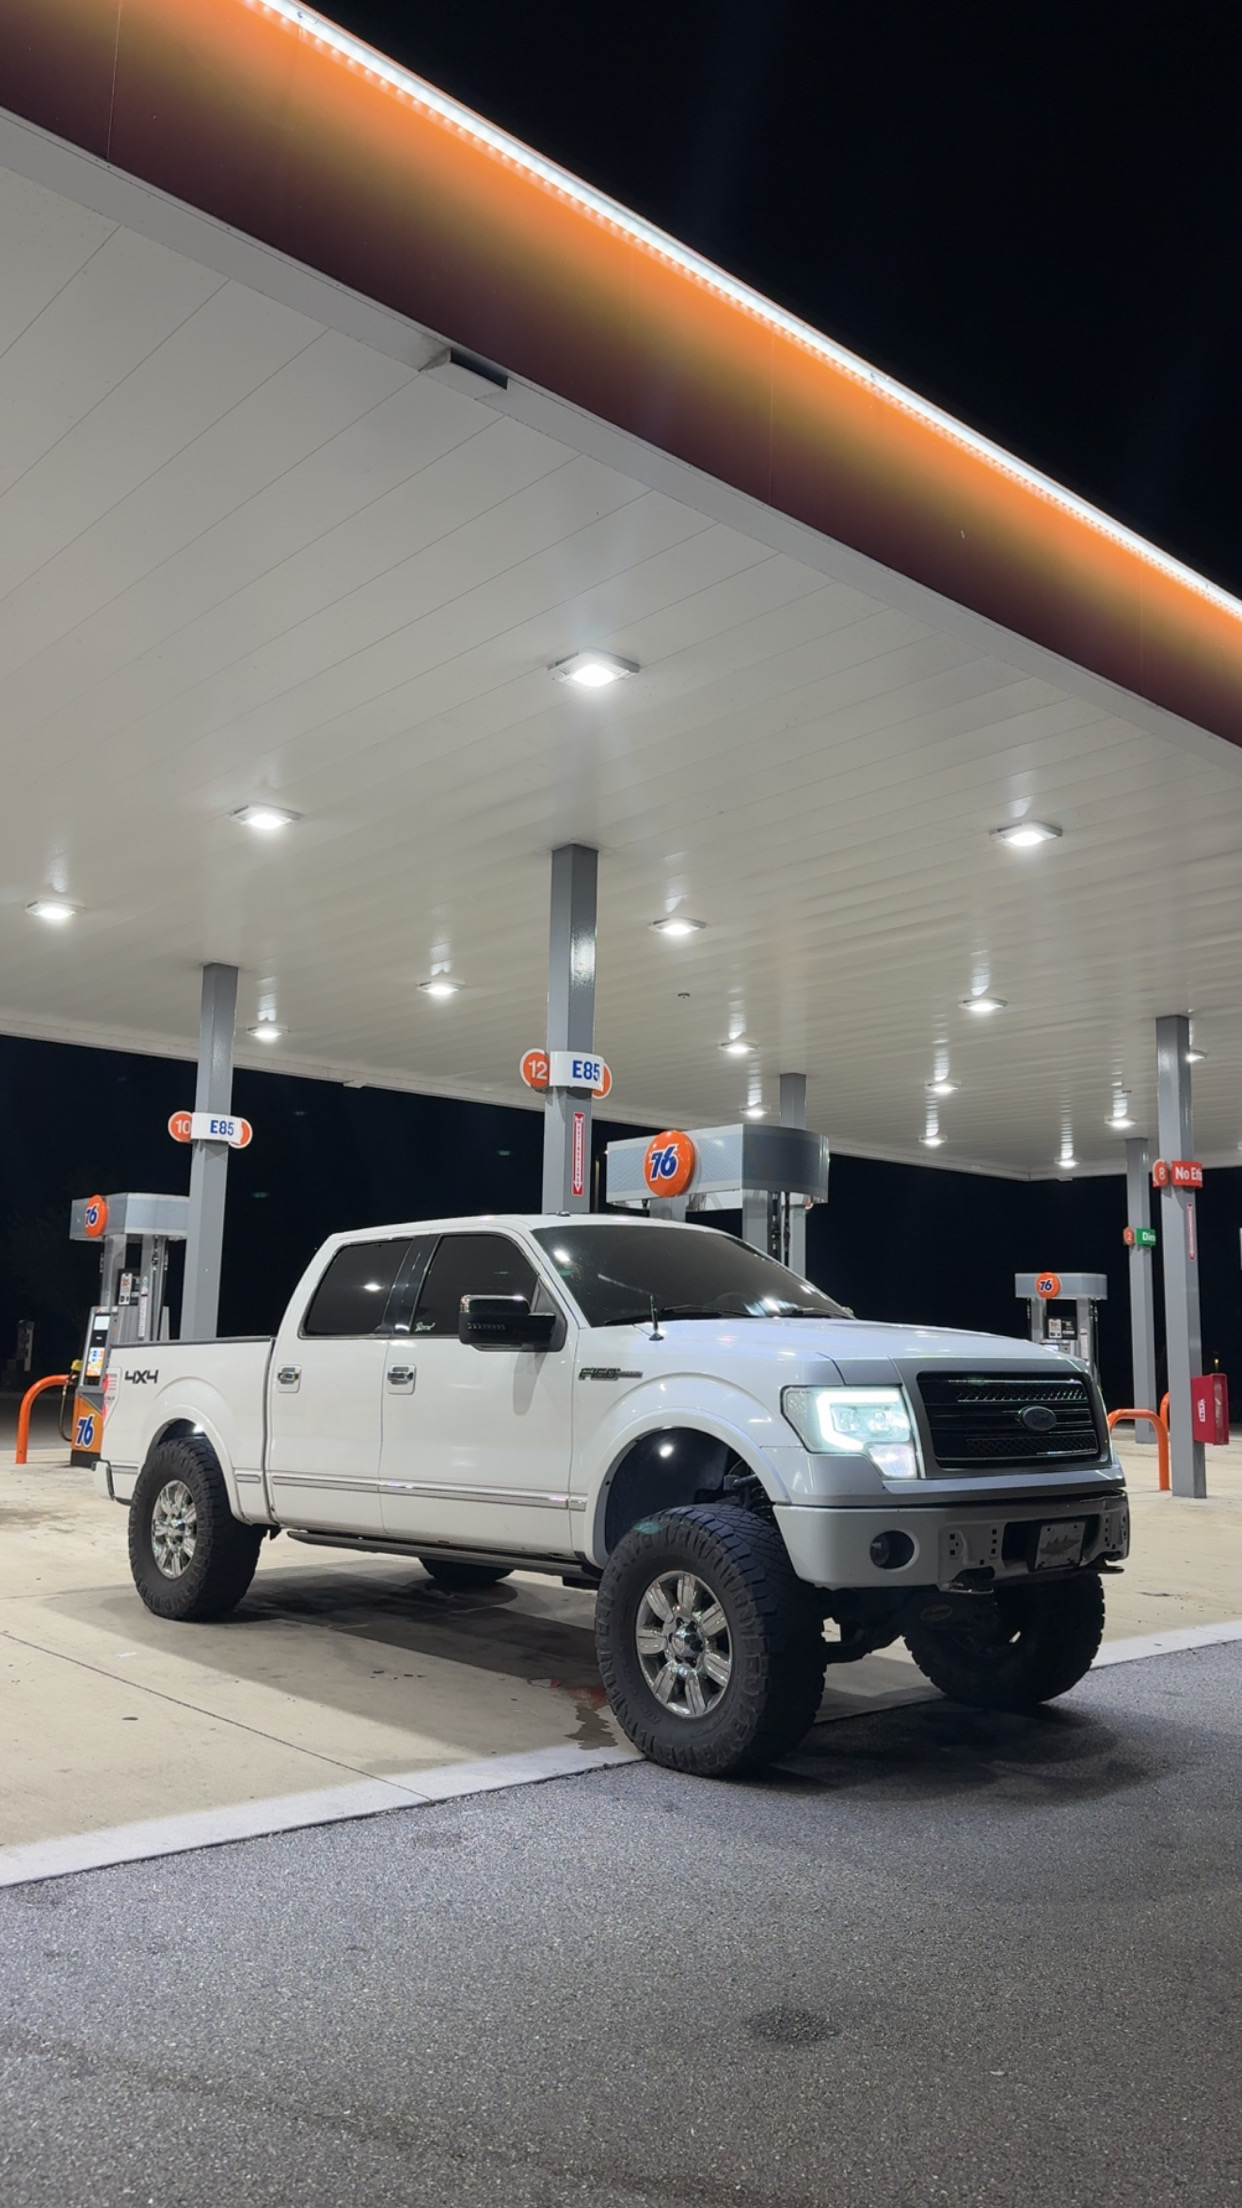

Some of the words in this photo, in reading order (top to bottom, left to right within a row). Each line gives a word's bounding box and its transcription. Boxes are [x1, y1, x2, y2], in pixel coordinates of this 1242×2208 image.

[528, 1060, 548, 1080] 12
[572, 1060, 600, 1082] E85
[176, 1119, 191, 1134] 10
[210, 1119, 234, 1136] E85
[650, 1143, 679, 1181] 76
[1175, 1166, 1190, 1180] No
[85, 1203, 100, 1228] 76
[1040, 1278, 1053, 1292] 76
[76, 1414, 94, 1448] 76
